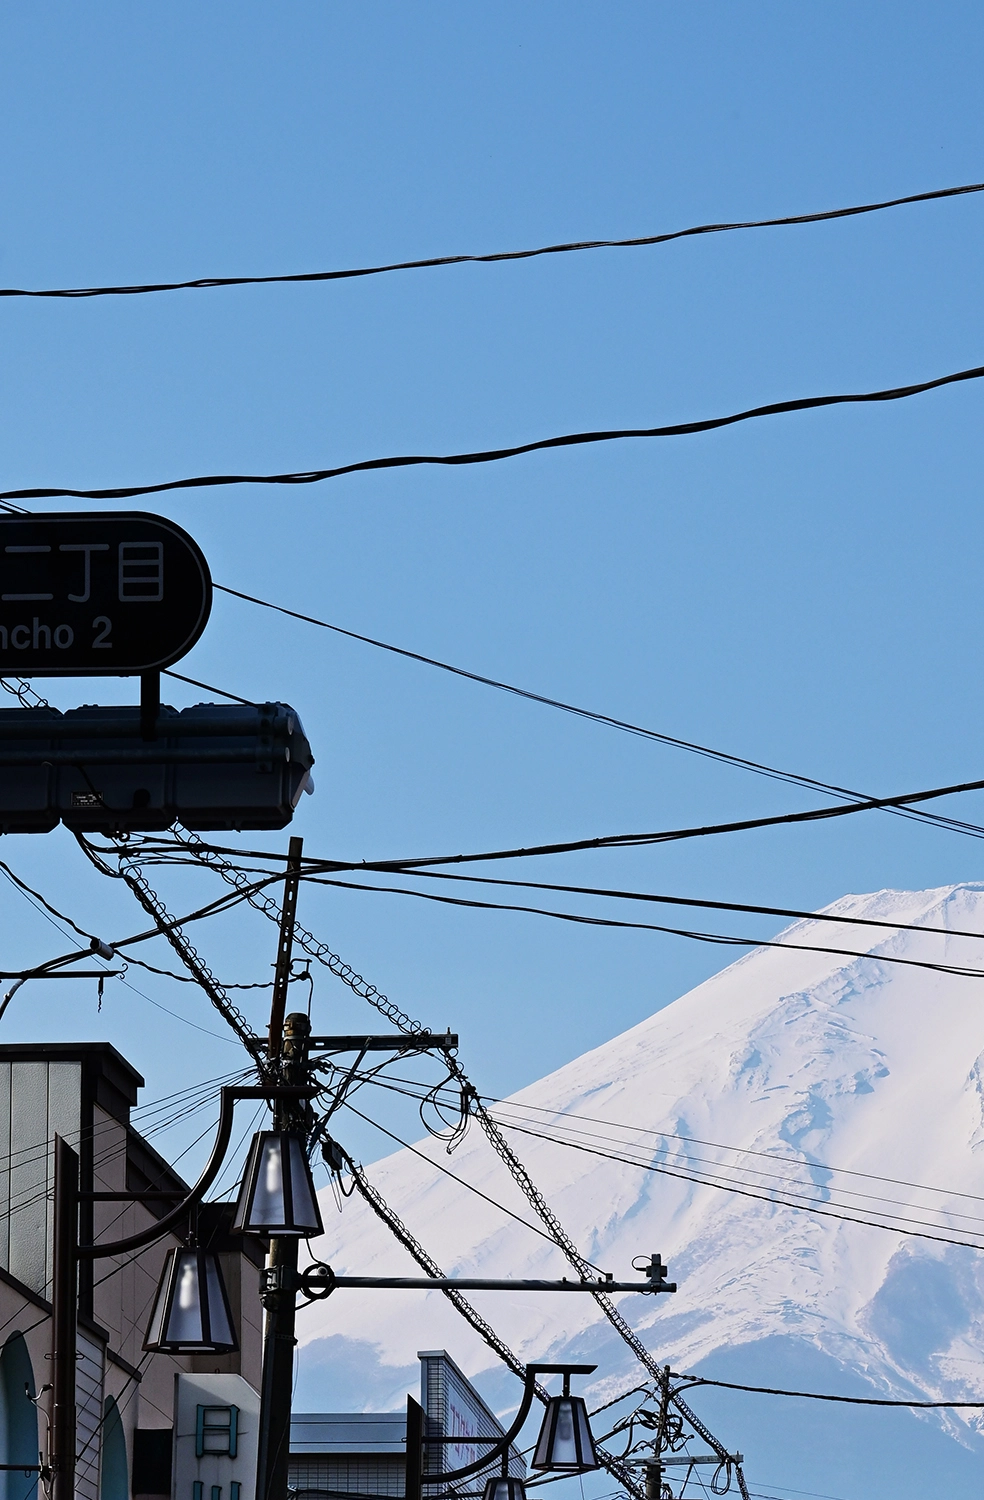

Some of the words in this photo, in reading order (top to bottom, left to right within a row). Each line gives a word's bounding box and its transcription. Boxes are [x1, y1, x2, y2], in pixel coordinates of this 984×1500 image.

[1, 541, 165, 603] 二丁目
[91, 615, 113, 649] 2
